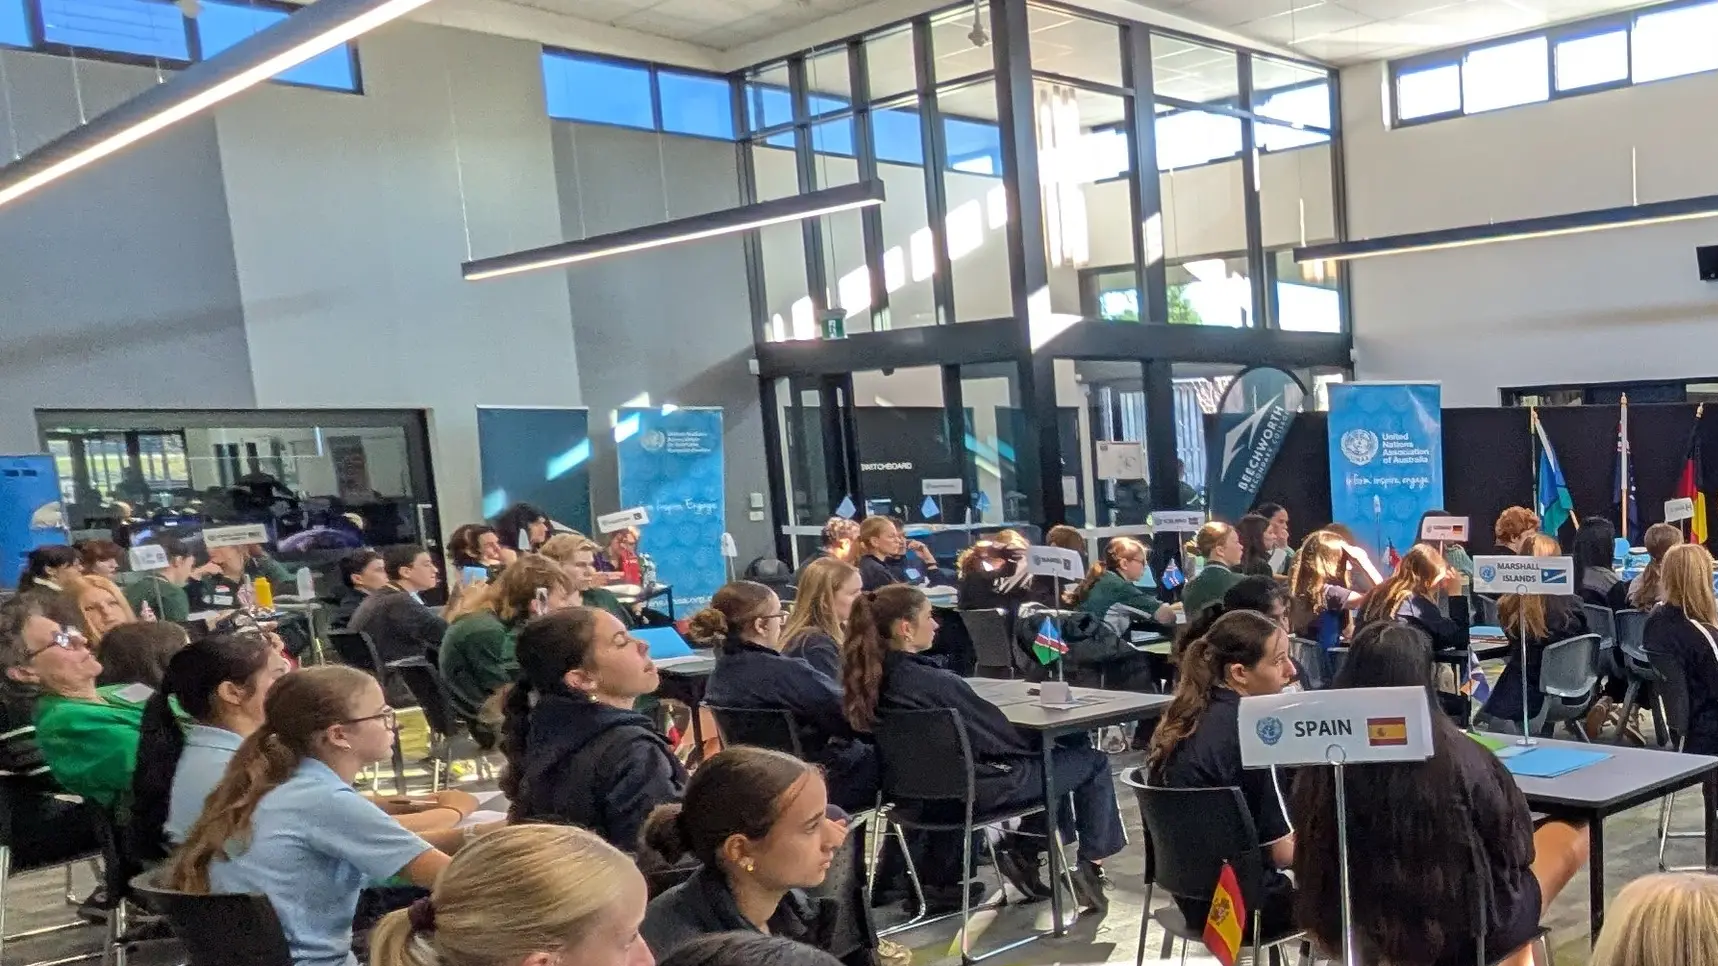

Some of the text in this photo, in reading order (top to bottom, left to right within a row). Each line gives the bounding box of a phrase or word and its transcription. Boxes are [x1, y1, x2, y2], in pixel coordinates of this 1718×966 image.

[1382, 433, 1409, 441] United
[1238, 405, 1284, 491] BEECHWORTH
[1382, 448, 1430, 456] Association
[1382, 456, 1391, 464] of
[1497, 562, 1540, 571] MARSHALL
[1502, 574, 1537, 583] ISLANDS
[1294, 718, 1353, 738] SPAIN
